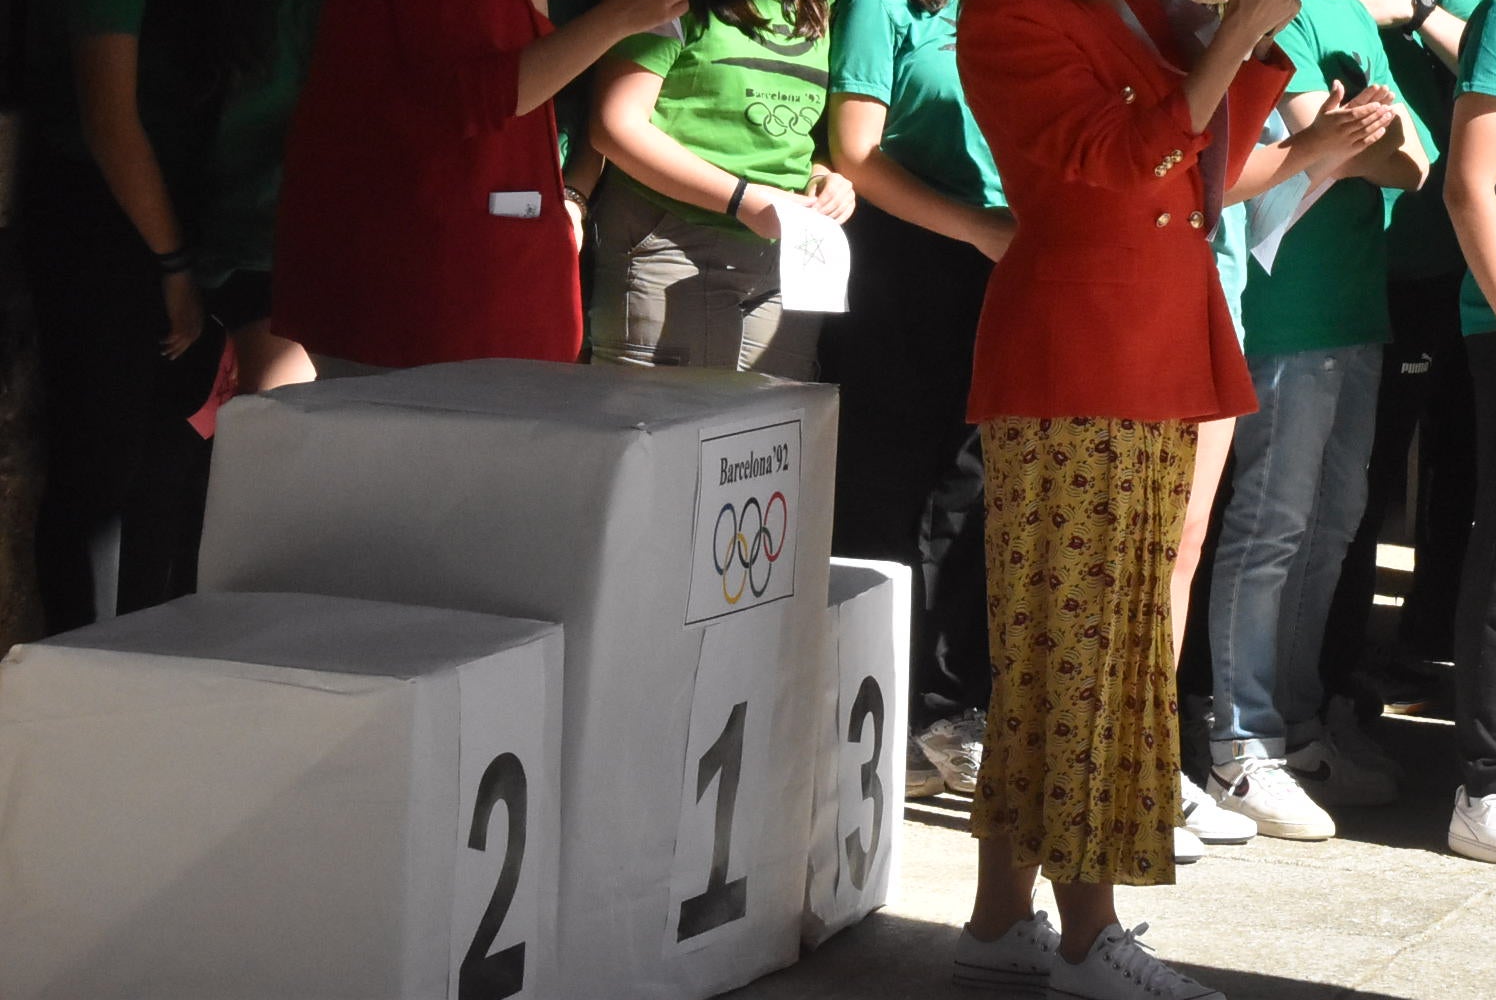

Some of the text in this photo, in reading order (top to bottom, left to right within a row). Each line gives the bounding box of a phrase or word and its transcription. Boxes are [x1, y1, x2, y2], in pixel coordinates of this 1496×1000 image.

[745, 88, 800, 102] Barcelona
[458, 752, 527, 1000] 2
[677, 701, 748, 943] 1
[845, 675, 884, 891] 3
